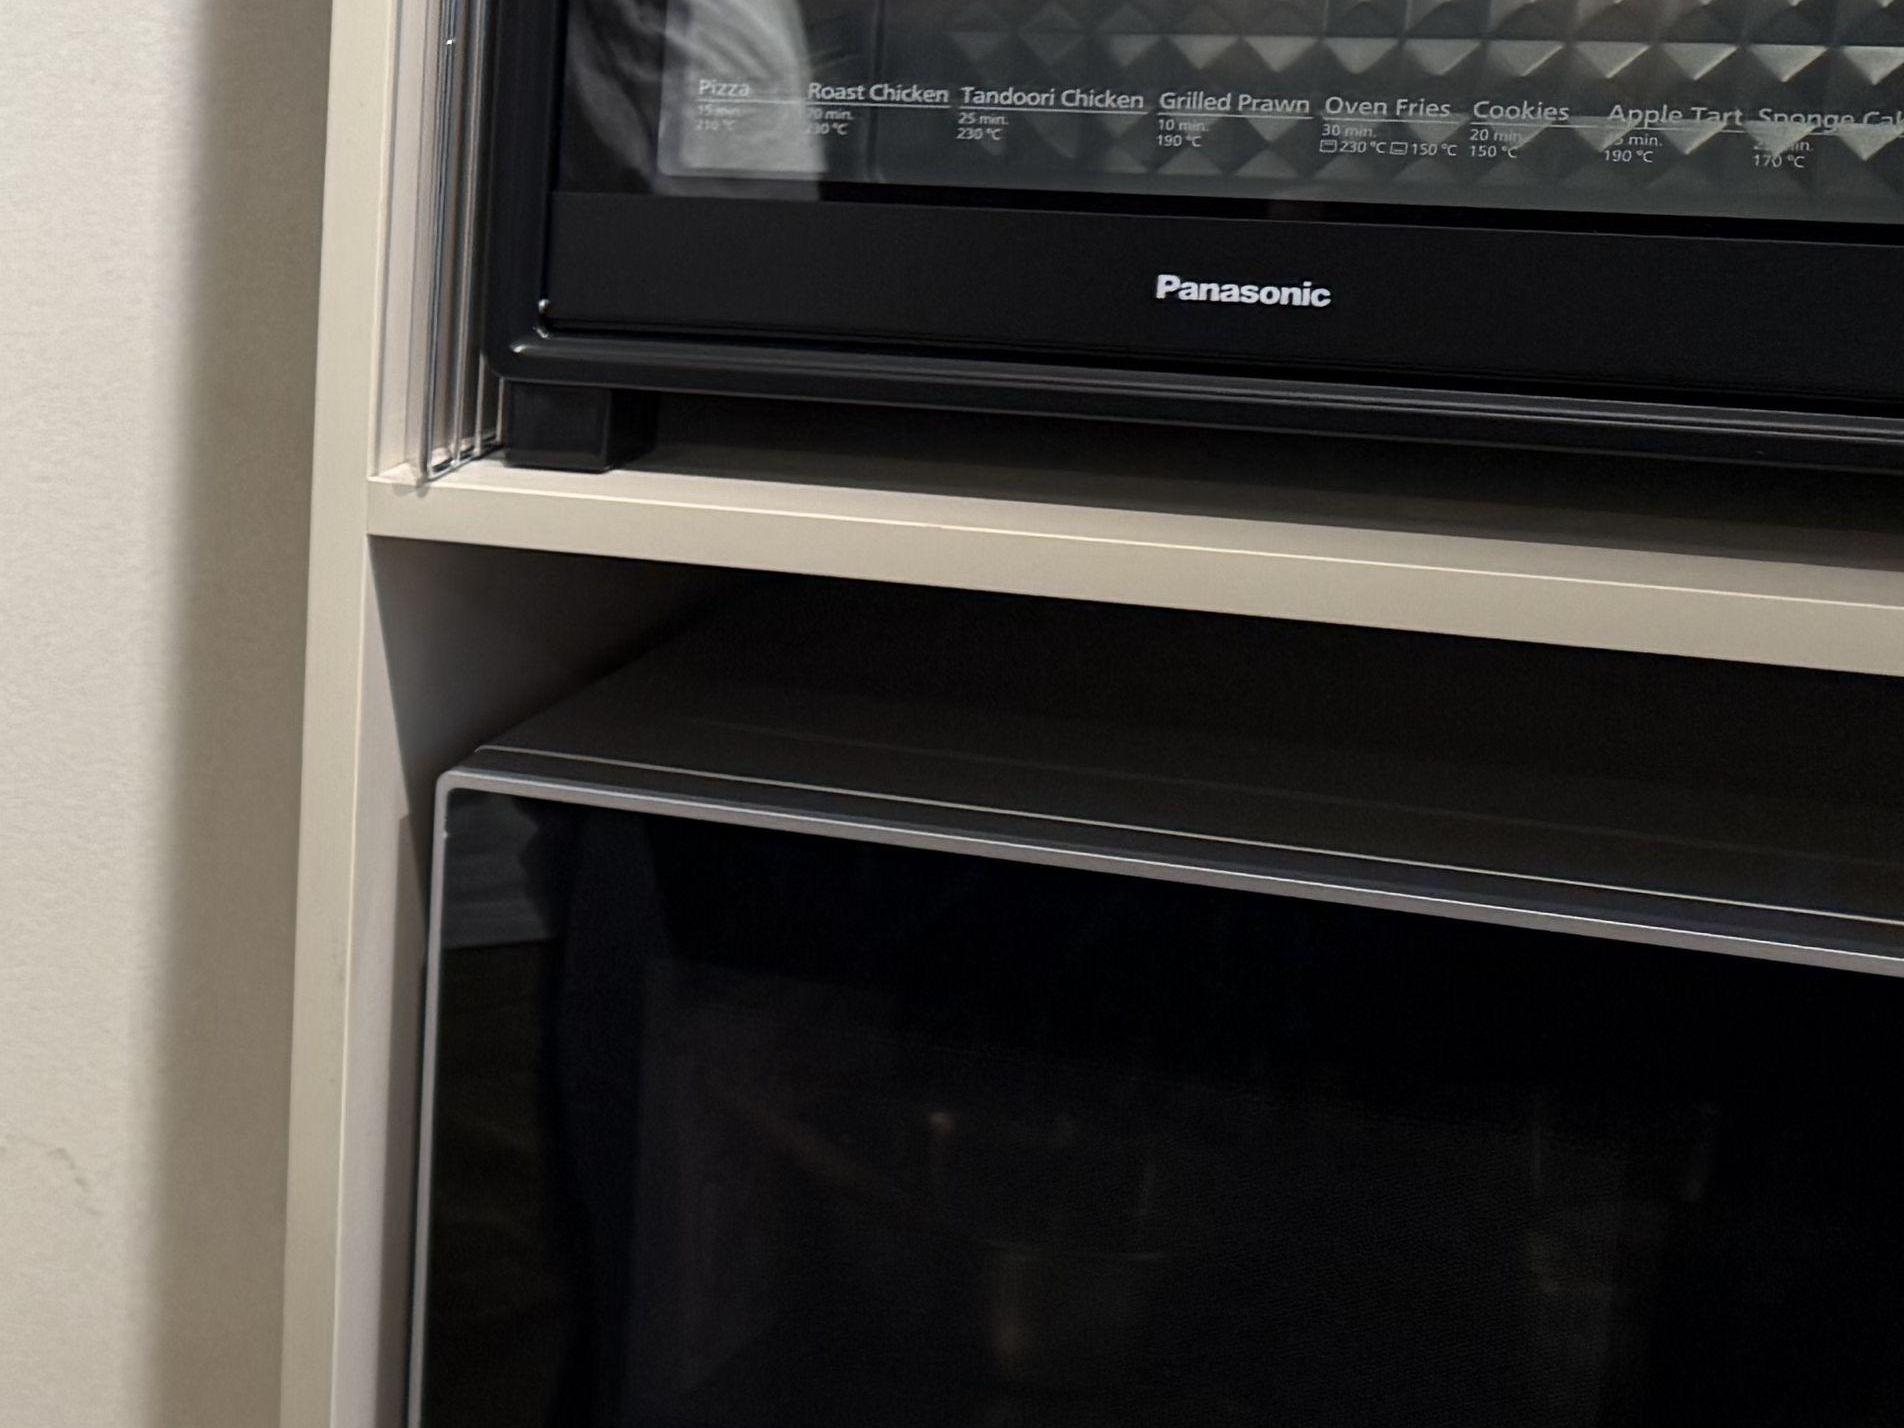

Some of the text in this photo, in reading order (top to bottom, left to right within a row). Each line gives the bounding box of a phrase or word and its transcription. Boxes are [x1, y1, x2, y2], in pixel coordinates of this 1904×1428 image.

[699, 79, 750, 97] Pizza
[808, 82, 949, 103] Roast Chicken
[961, 86, 1144, 109] Tandoori Chicken
[1159, 91, 1310, 114] Grilled Prawn
[1325, 95, 1451, 118] Oven Fries
[1473, 100, 1570, 122] Cookies
[958, 112, 1009, 125] 25 min.
[1607, 104, 1742, 130] Apple Tart
[1159, 119, 1210, 132] 10 min.
[1322, 124, 1377, 139] 30 min.
[957, 127, 1001, 141] 230 °C
[1156, 135, 1182, 147] 190
[1470, 129, 1489, 141] 20
[1629, 133, 1663, 147] min.
[1339, 141, 1458, 156] 230 °C 150 °C
[1470, 146, 1497, 158] 150
[1603, 149, 1654, 163] 190 °C
[1753, 154, 1806, 169] 170 °C
[1155, 273, 1332, 308] Panasonic
